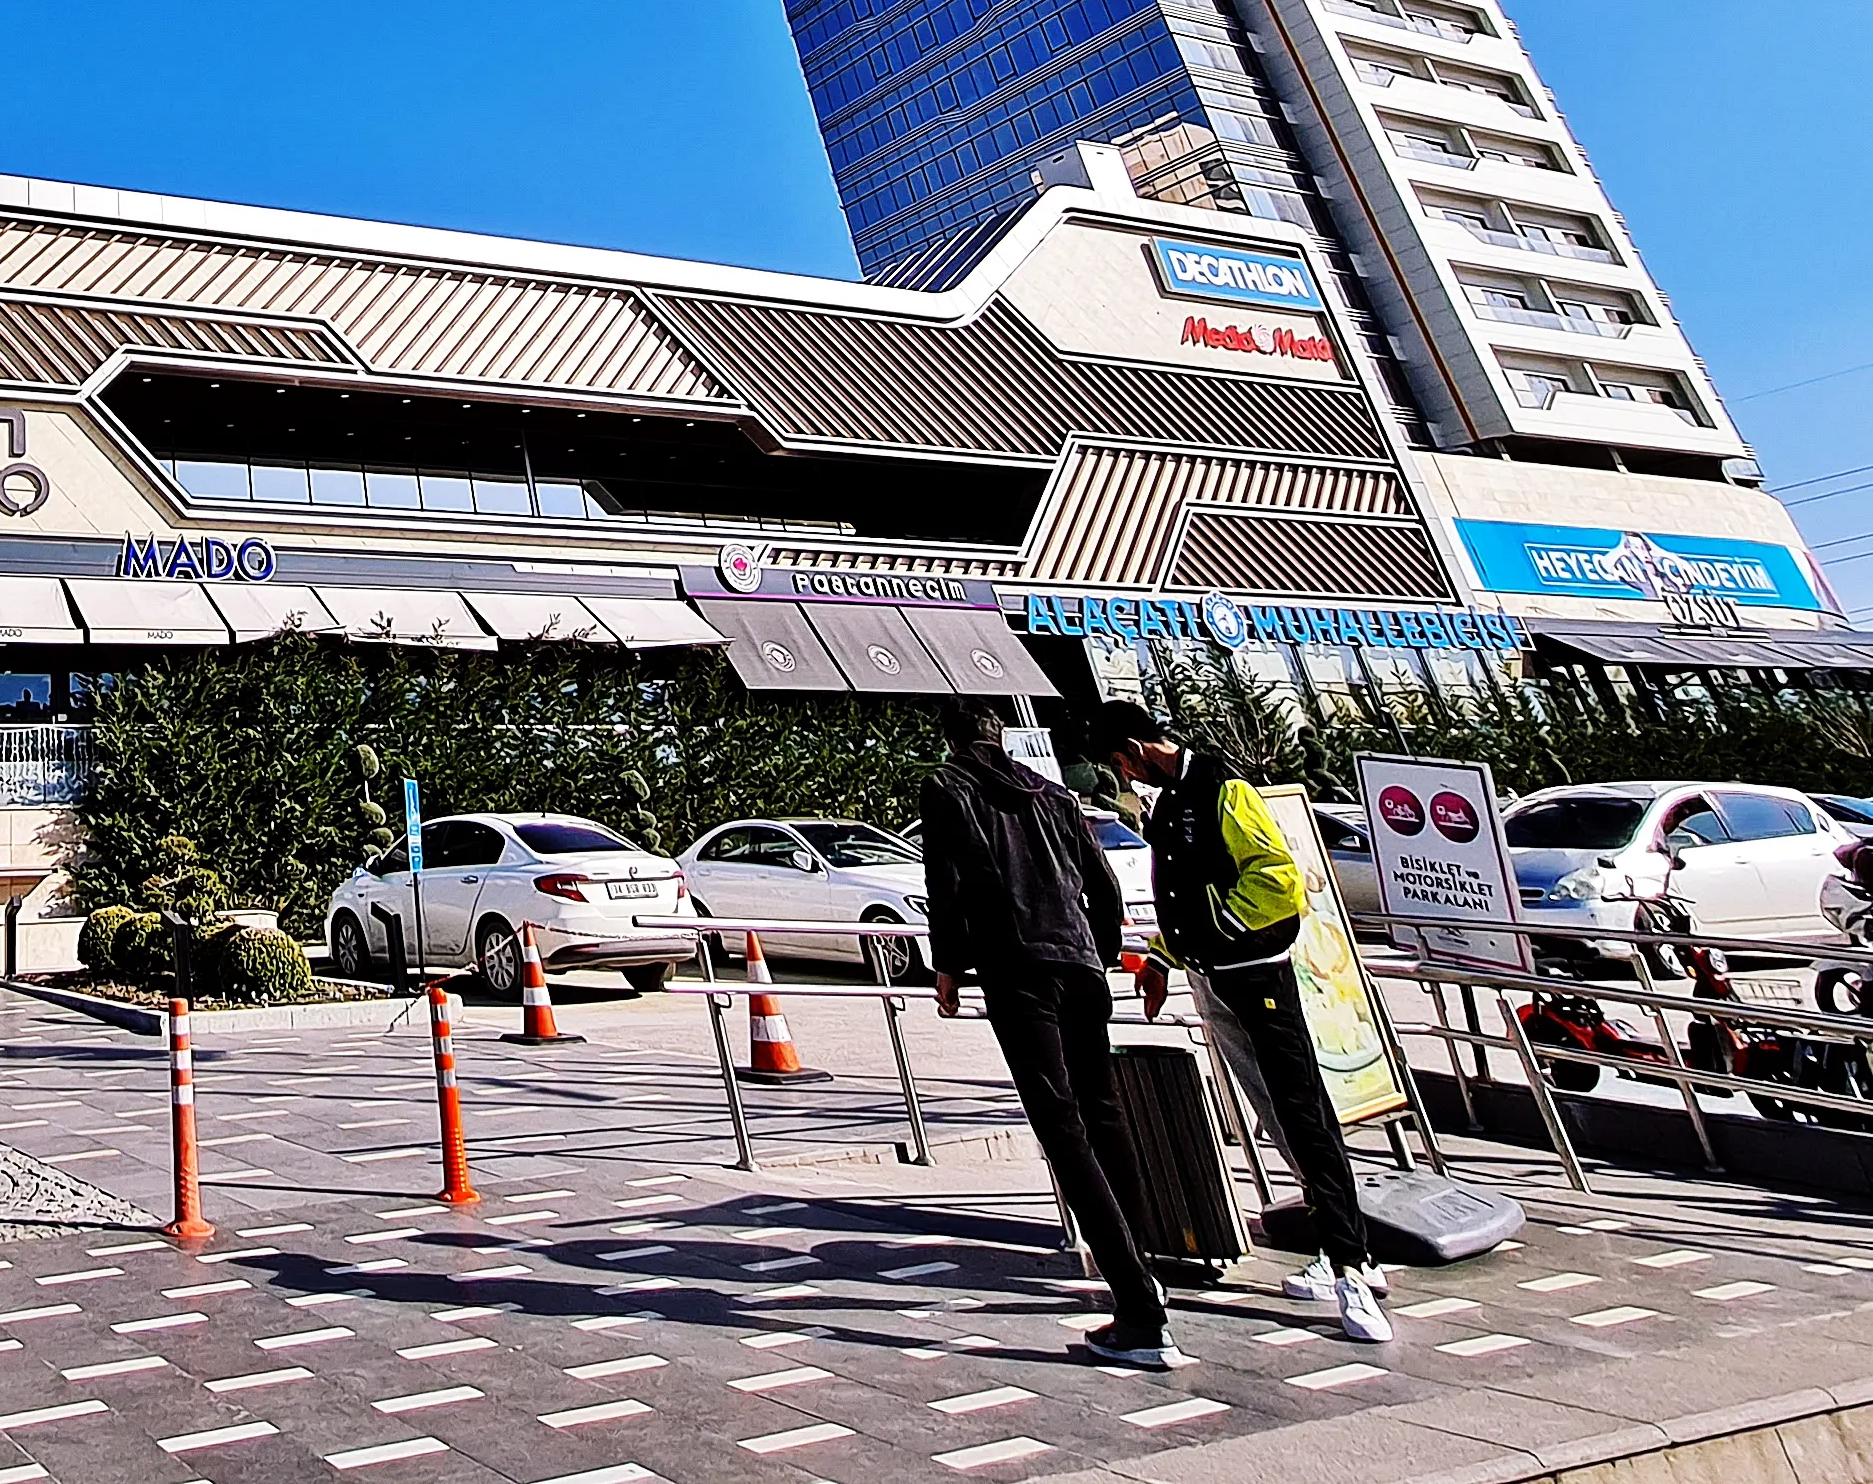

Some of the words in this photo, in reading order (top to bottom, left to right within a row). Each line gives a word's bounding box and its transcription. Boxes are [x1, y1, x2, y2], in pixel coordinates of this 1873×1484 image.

[1167, 248, 1311, 299] DECATHLON
[122, 530, 277, 582] MADO
[1028, 592, 1202, 646] ALAÇATI
[146, 629, 174, 640] MADO
[1399, 854, 1462, 877] BİSİKLET
[1392, 870, 1494, 897] MOTORSİKLET
[1402, 886, 1442, 905] PARK
[1443, 893, 1491, 913] ALANI
